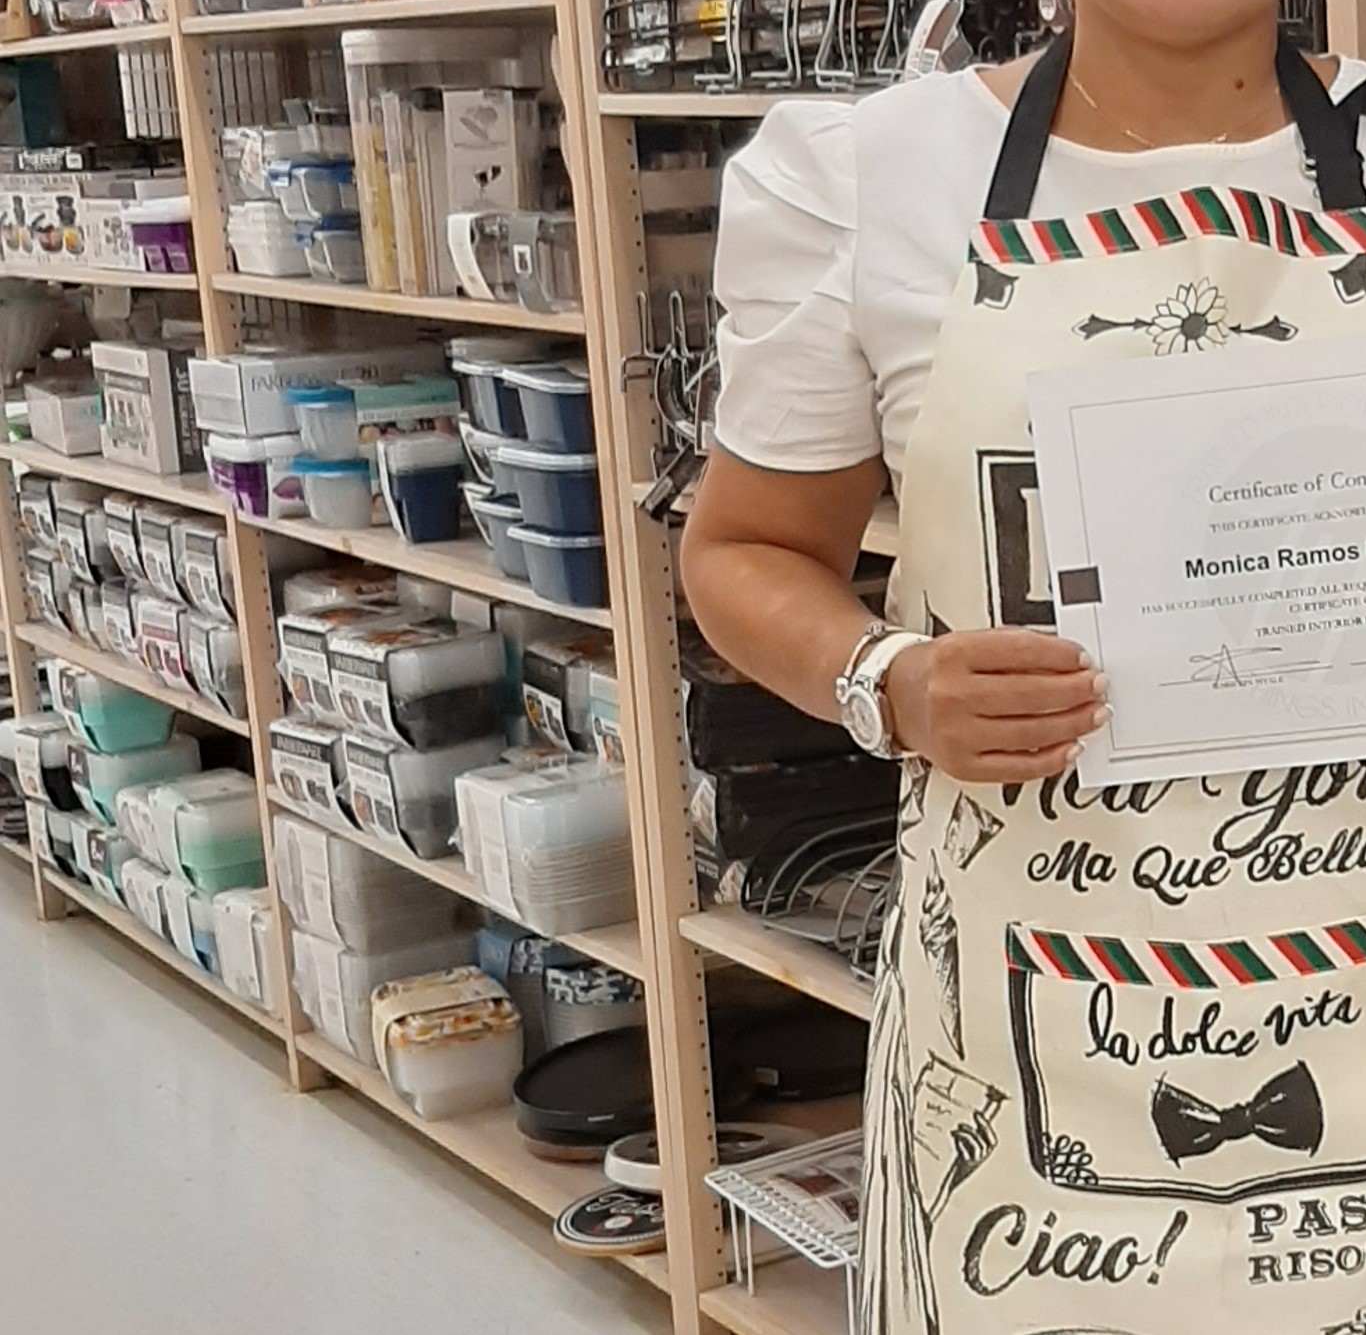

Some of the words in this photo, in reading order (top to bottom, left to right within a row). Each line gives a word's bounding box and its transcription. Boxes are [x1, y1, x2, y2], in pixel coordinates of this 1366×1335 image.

[1208, 480, 1298, 504] Certificate
[1303, 473, 1325, 493] of
[1210, 522, 1236, 534] THIS
[1238, 513, 1309, 531] CERTIFICATE
[1184, 554, 1270, 579] Monica
[1277, 544, 1360, 569] Ramos
[1248, 586, 1318, 602] COMPLETED
[1320, 583, 1341, 595] ALL
[1289, 596, 1361, 614] CERTIFICATE
[1255, 622, 1307, 638] TRAINED
[1308, 617, 1363, 632] INTERIOR
[1026, 839, 1118, 893] Ma
[1131, 846, 1231, 906] Que
[1084, 980, 1141, 1067] la
[1146, 996, 1260, 1064] dolce
[1263, 987, 1363, 1045] vita
[961, 1200, 1190, 1298] Ciao!
